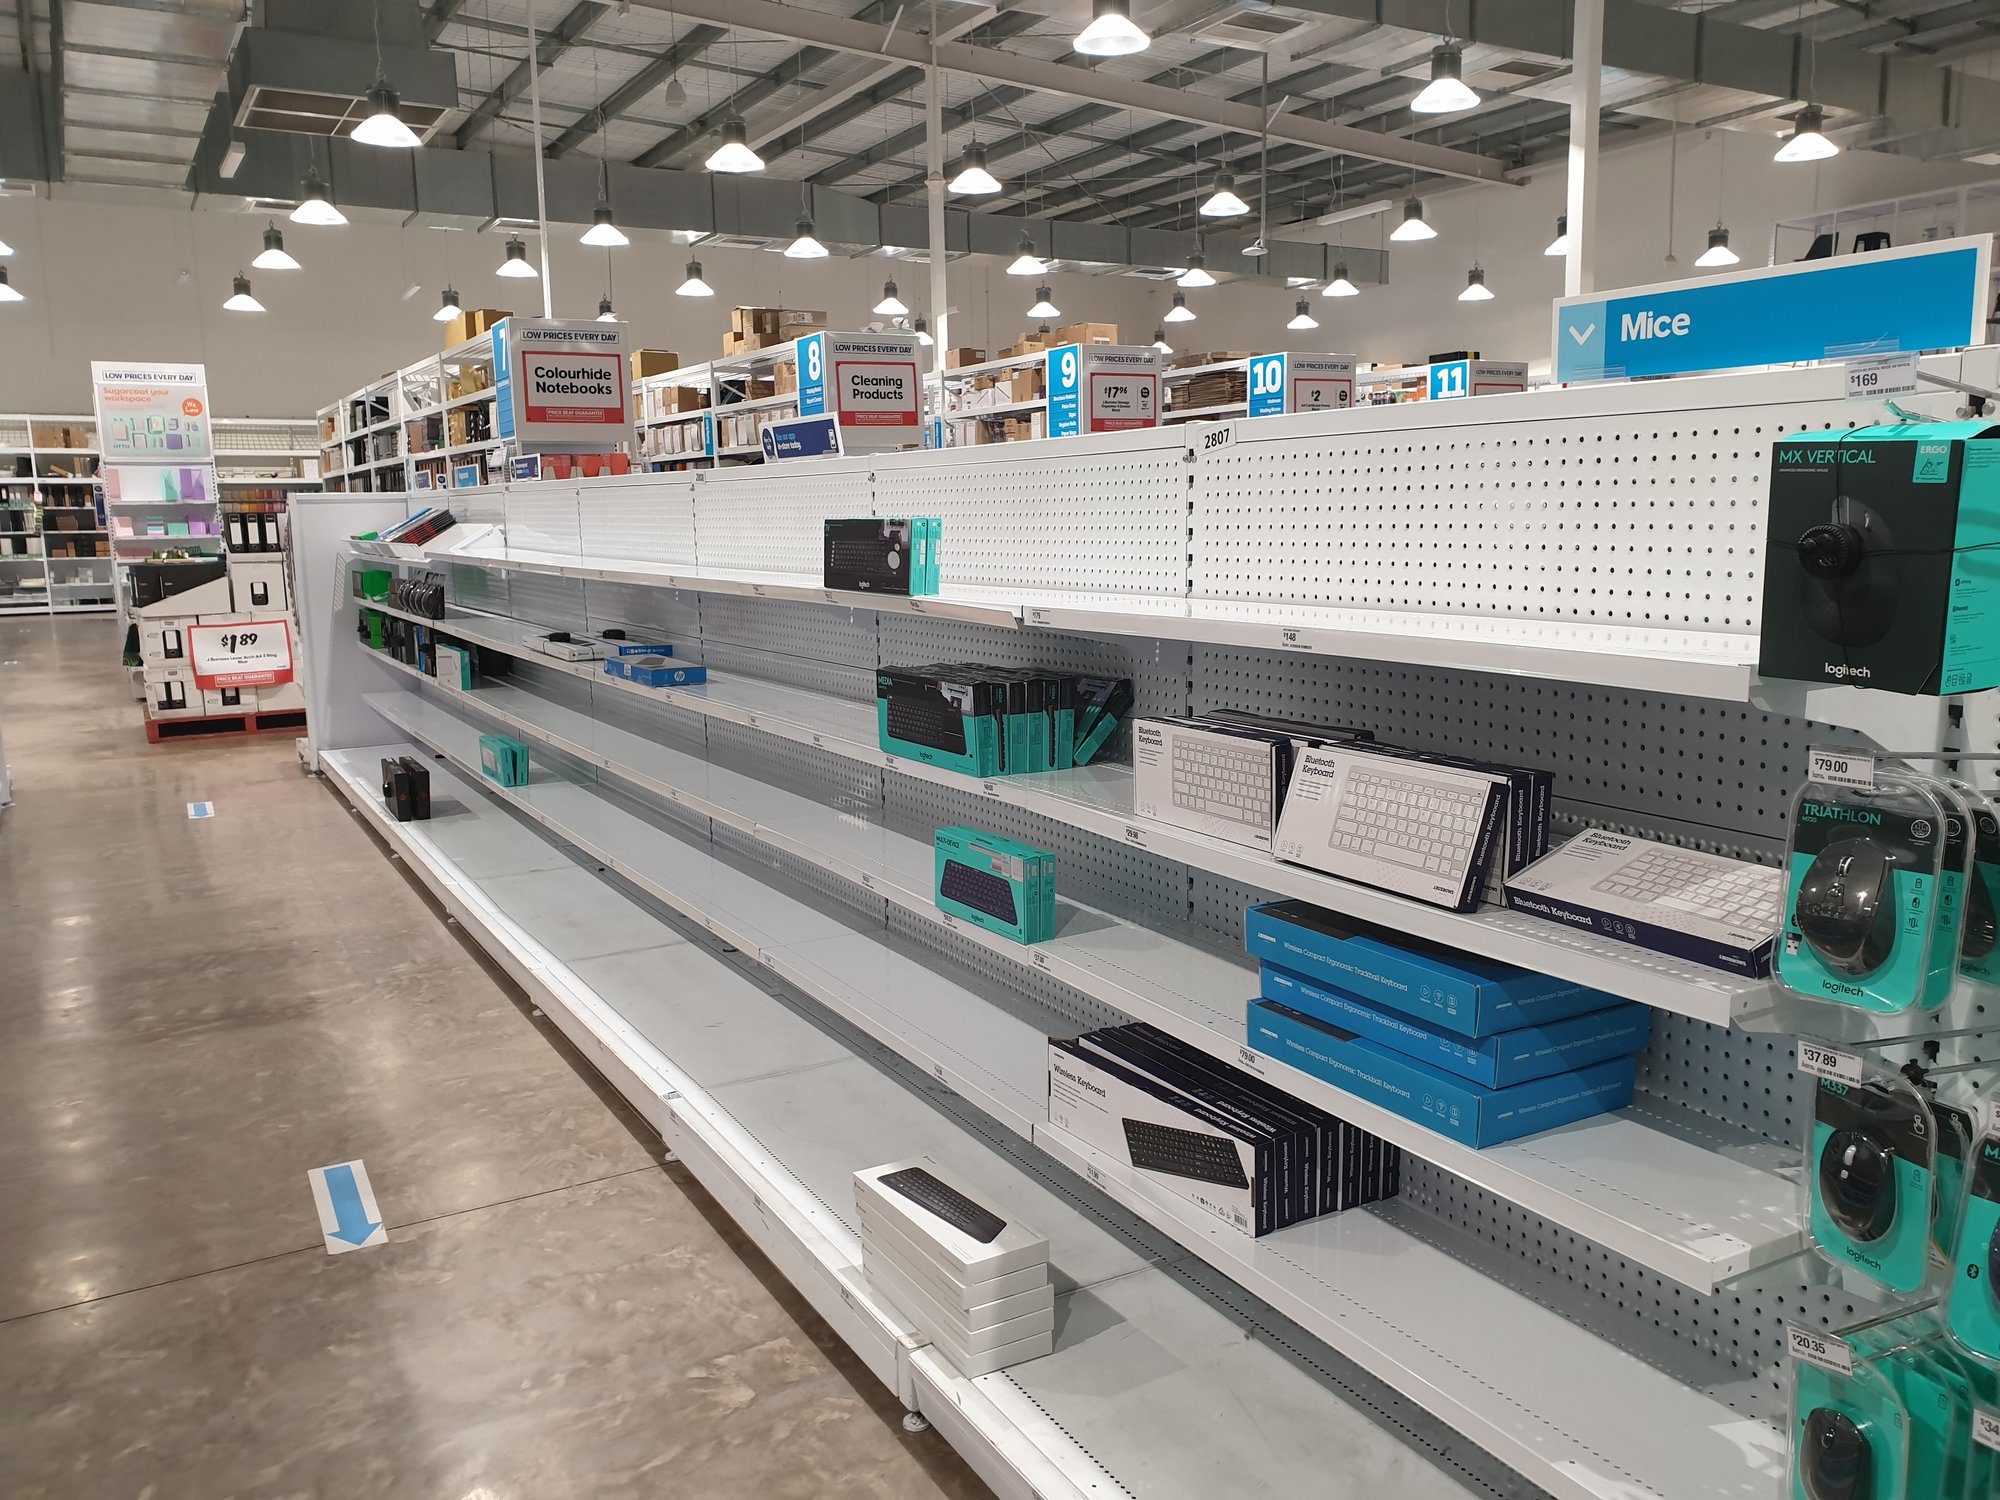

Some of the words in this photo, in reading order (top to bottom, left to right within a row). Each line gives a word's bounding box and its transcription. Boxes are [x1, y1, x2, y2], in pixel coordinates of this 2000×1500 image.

[1621, 311, 1691, 342] Mice
[522, 331, 541, 339] LOW
[543, 332, 573, 340] PRICES
[574, 333, 599, 341] EVERY
[601, 334, 616, 342] DAY
[835, 344, 850, 352] LOW
[852, 344, 876, 352] PRICES
[878, 345, 898, 353] EVERY
[899, 346, 912, 354] DAY
[808, 341, 821, 381] 8
[1104, 355, 1125, 363] PRICES
[1125, 356, 1142, 364] EVERY
[534, 366, 612, 381] Colourhide
[1061, 352, 1076, 389] 9
[1252, 360, 1282, 395] 10
[1850, 372, 1878, 387] $169
[535, 382, 613, 395] Notebooks
[851, 375, 903, 389] Cleaning
[1437, 366, 1465, 399] 11
[103, 387, 149, 396] Sugarcoat
[852, 389, 903, 400] Products
[1311, 390, 1321, 401] $2
[1204, 428, 1230, 450] 2807
[1779, 450, 1803, 464] MX
[1807, 449, 1876, 464] VERTICAL
[1920, 445, 1948, 454] ERGO
[878, 675, 893, 686] MEDIA
[1138, 726, 1161, 738] Bluetooth
[1138, 735, 1163, 747] Keyboard
[1304, 754, 1336, 769] Bluetooth
[1815, 758, 1848, 774] $79.00
[1301, 764, 1335, 779] Keyboard
[1537, 785, 1546, 821] Keyboard
[1803, 803, 1882, 826] TRIATHLON
[1476, 833, 1490, 866] Bluetooth
[1486, 794, 1501, 832] Keyboard
[1589, 832, 1631, 846] Bluetooth
[1535, 822, 1543, 857] Bluetooth
[1582, 837, 1628, 851] Keyboard
[1513, 896, 1550, 914] Bluetooth
[1550, 906, 1592, 926] Keyboard
[1284, 941, 1302, 954] Wireless
[1303, 947, 1325, 962] Compact
[1326, 955, 1353, 973] Ergonomic
[1354, 966, 1380, 982] Trackball
[1380, 974, 1408, 991] Keyboard
[1822, 979, 1864, 998] logitech
[1301, 987, 1319, 1001] Wireless
[1320, 992, 1343, 1009] Compact
[1343, 1001, 1371, 1020] Ergonomic
[1372, 1013, 1398, 1030] Trackball
[1399, 1023, 1427, 1040] Keyboard
[1804, 1048, 1837, 1068] $37.89
[1285, 1038, 1304, 1053] Wireless
[1305, 1046, 1328, 1062] Compact
[1328, 1054, 1356, 1075] Ergonomic
[1357, 1069, 1382, 1087] Trackball
[1383, 1079, 1411, 1098] Keyboard
[1053, 1063, 1077, 1085] Wireless
[1077, 1075, 1106, 1098] Keyboard
[1821, 1078, 1849, 1096] M337
[1194, 1108, 1229, 1128] Keyboard
[1216, 1100, 1250, 1119] Keyboard
[1249, 1116, 1277, 1134] Wireless
[1985, 1143, 2000, 1160] M
[1847, 1246, 1881, 1271] logitech
